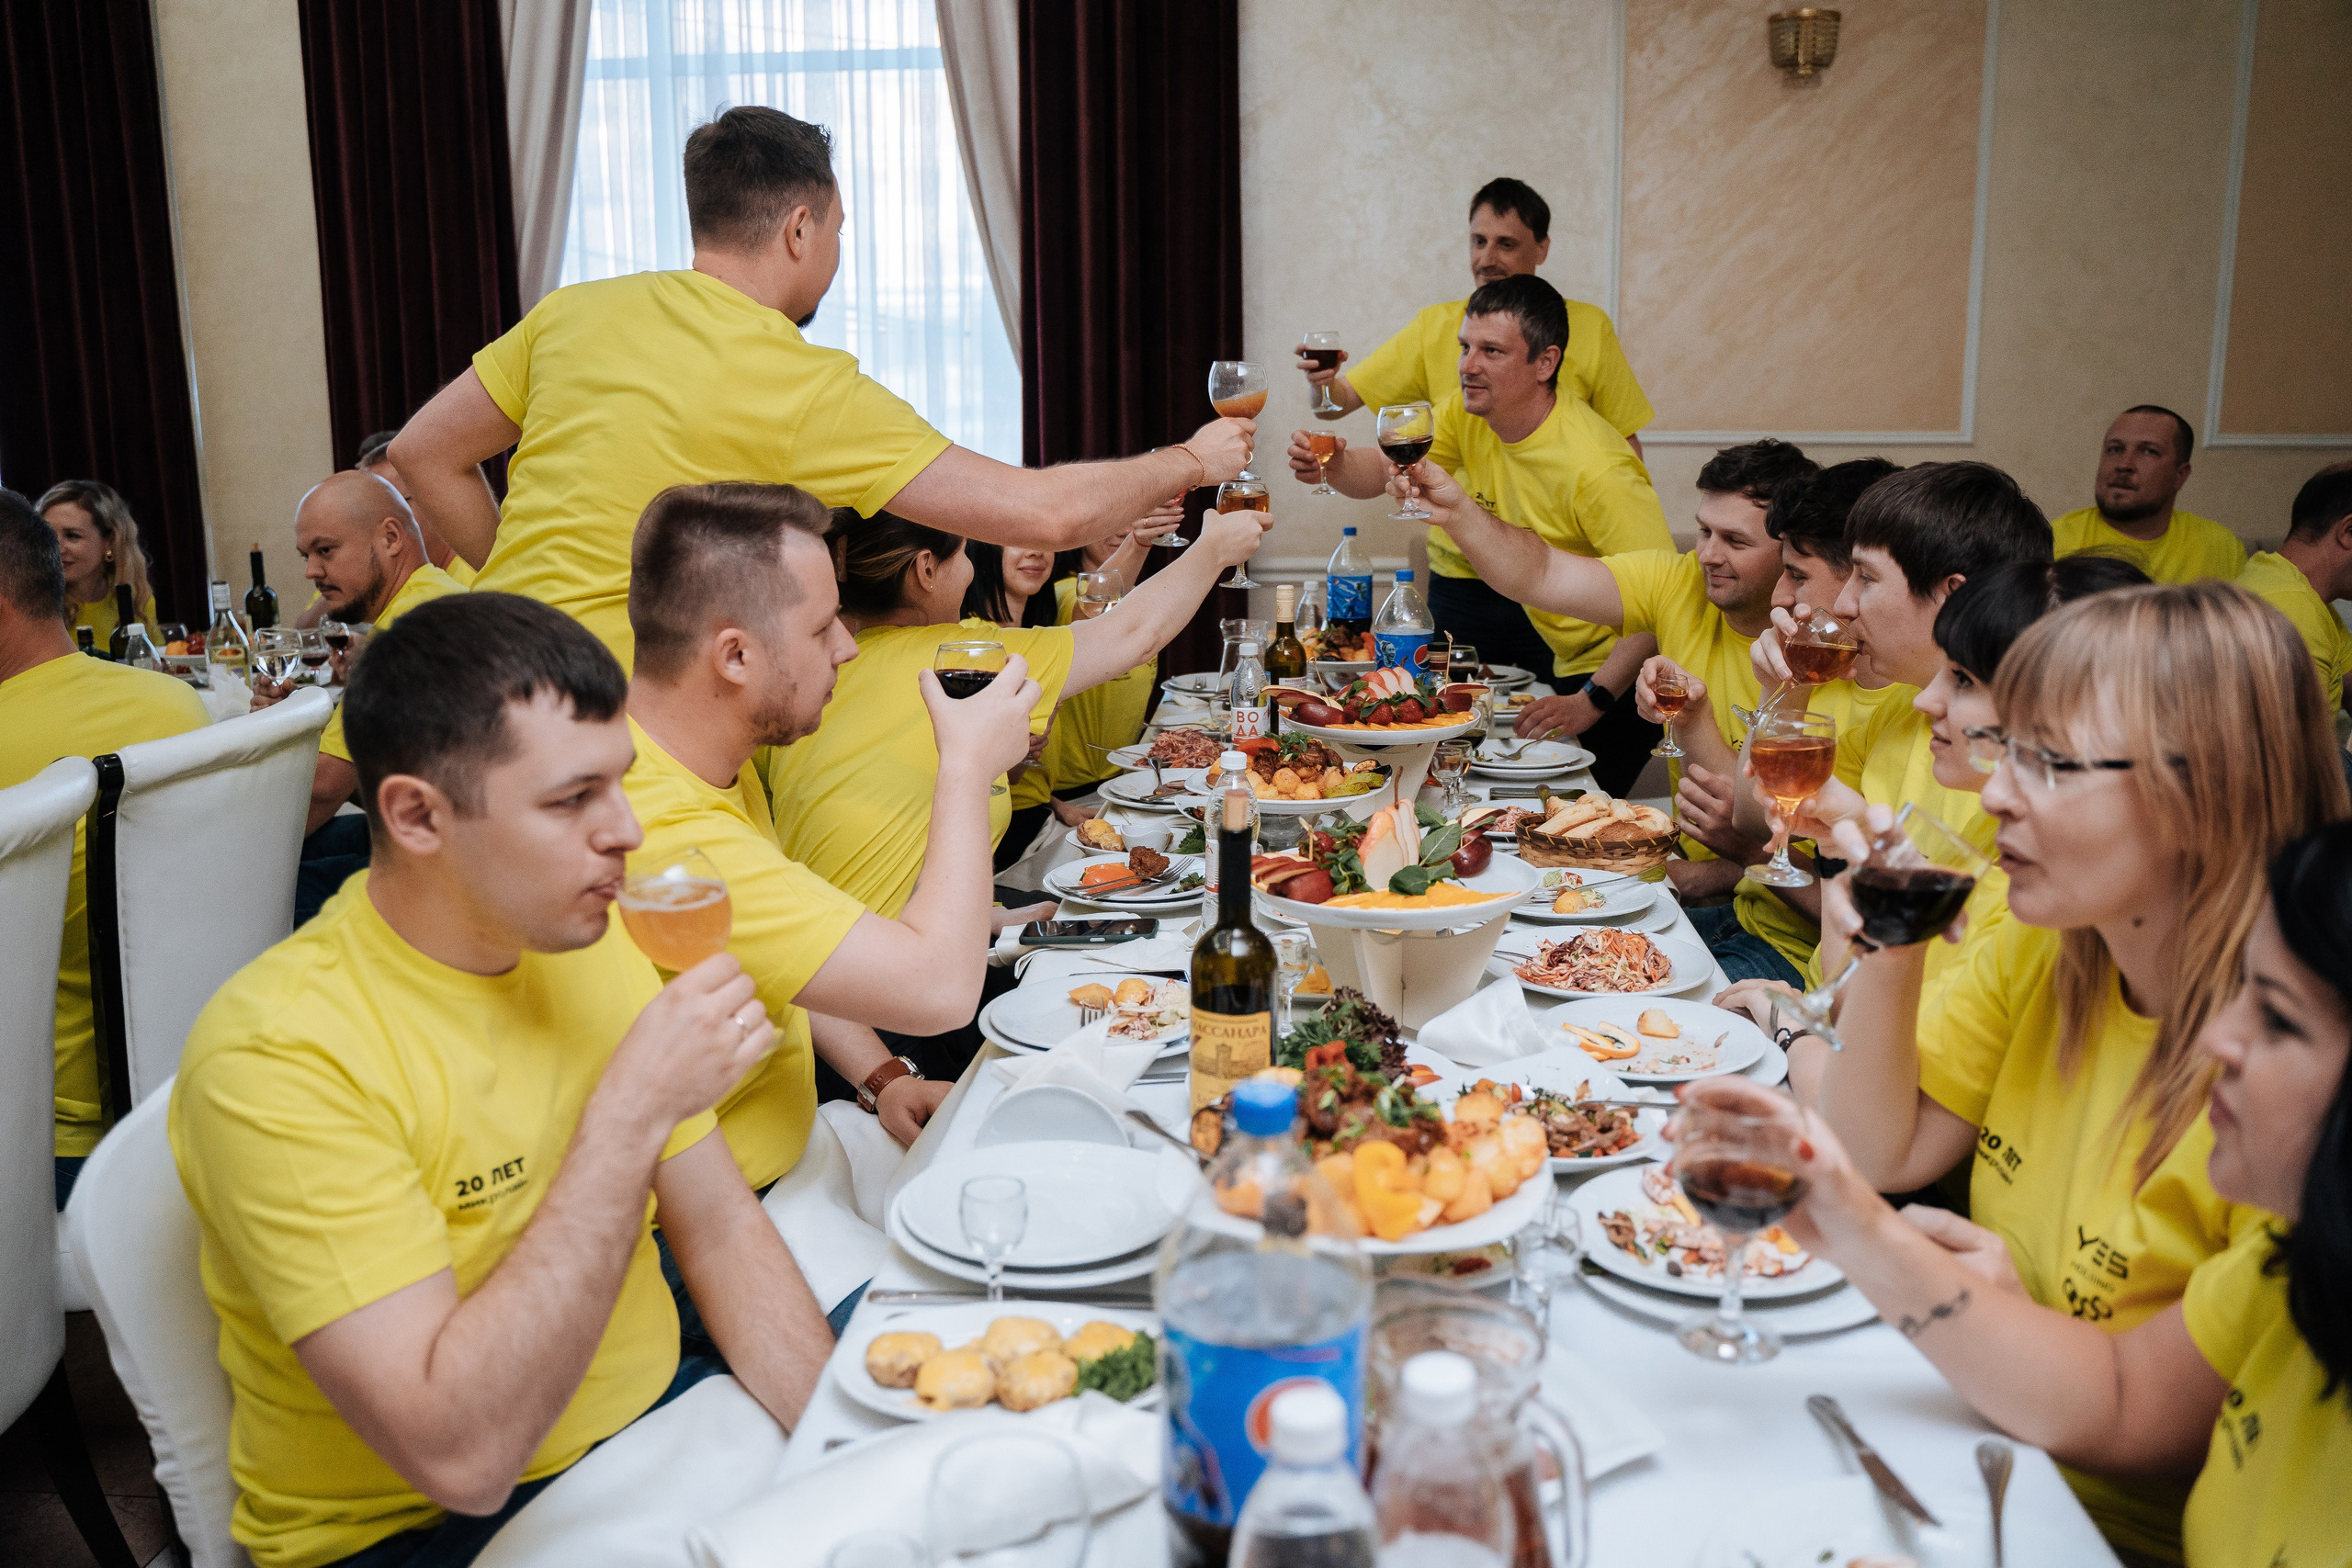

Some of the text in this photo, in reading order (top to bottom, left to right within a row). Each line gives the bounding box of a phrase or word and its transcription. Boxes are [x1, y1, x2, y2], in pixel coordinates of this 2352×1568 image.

[1980, 1125, 2002, 1150] 20
[455, 1176, 484, 1197] 20
[492, 1156, 525, 1186] ЛЕТ
[2078, 1224, 2129, 1280] YES
